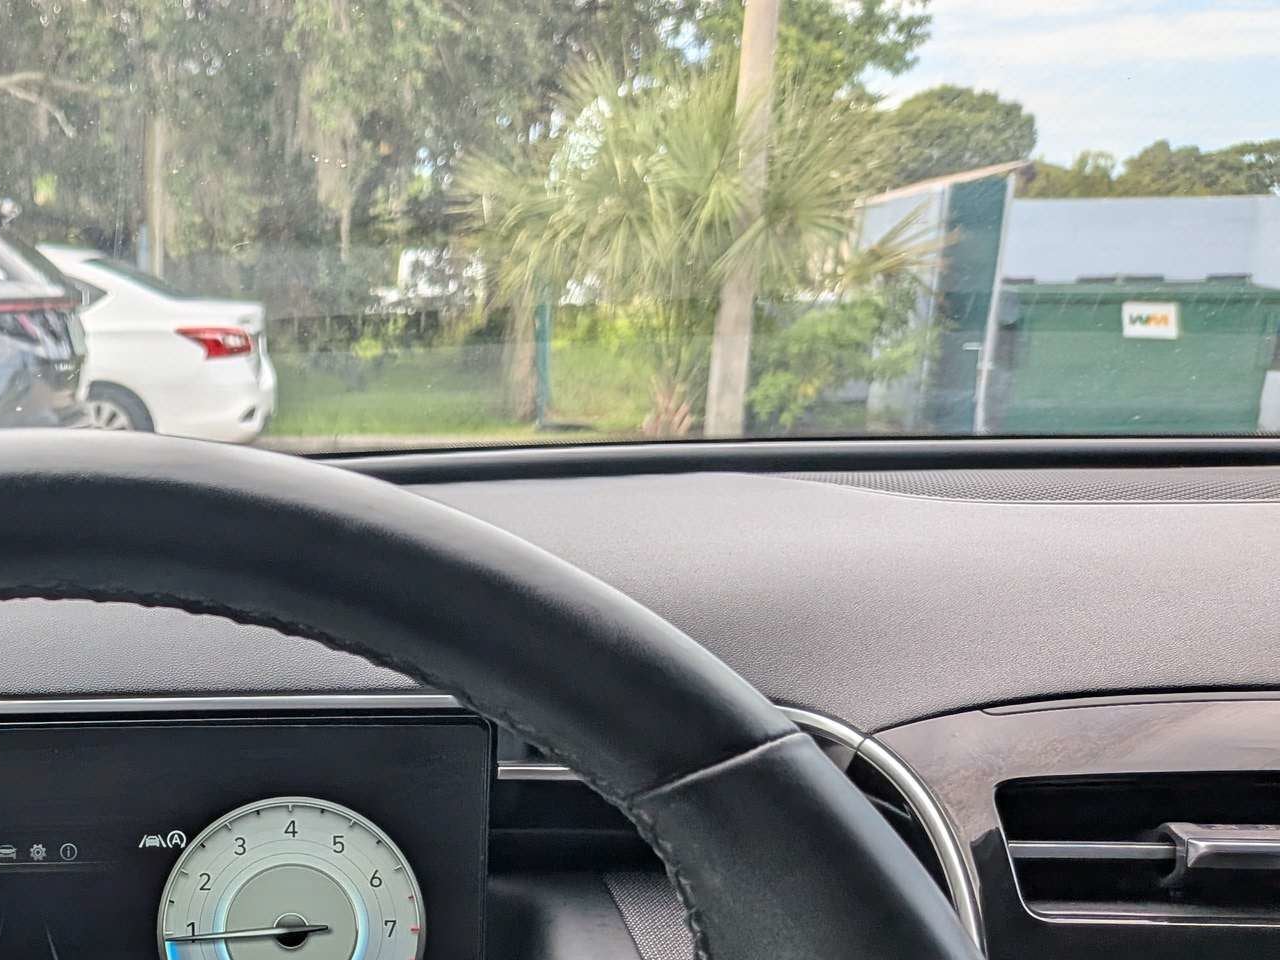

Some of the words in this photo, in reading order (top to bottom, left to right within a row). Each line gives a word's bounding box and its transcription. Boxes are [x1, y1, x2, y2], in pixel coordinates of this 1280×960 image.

[284, 820, 298, 838] 4
[234, 838, 247, 856] 3
[332, 836, 345, 853] 5
[199, 873, 212, 890] 2
[370, 870, 382, 887] 6
[384, 920, 397, 937] 7
